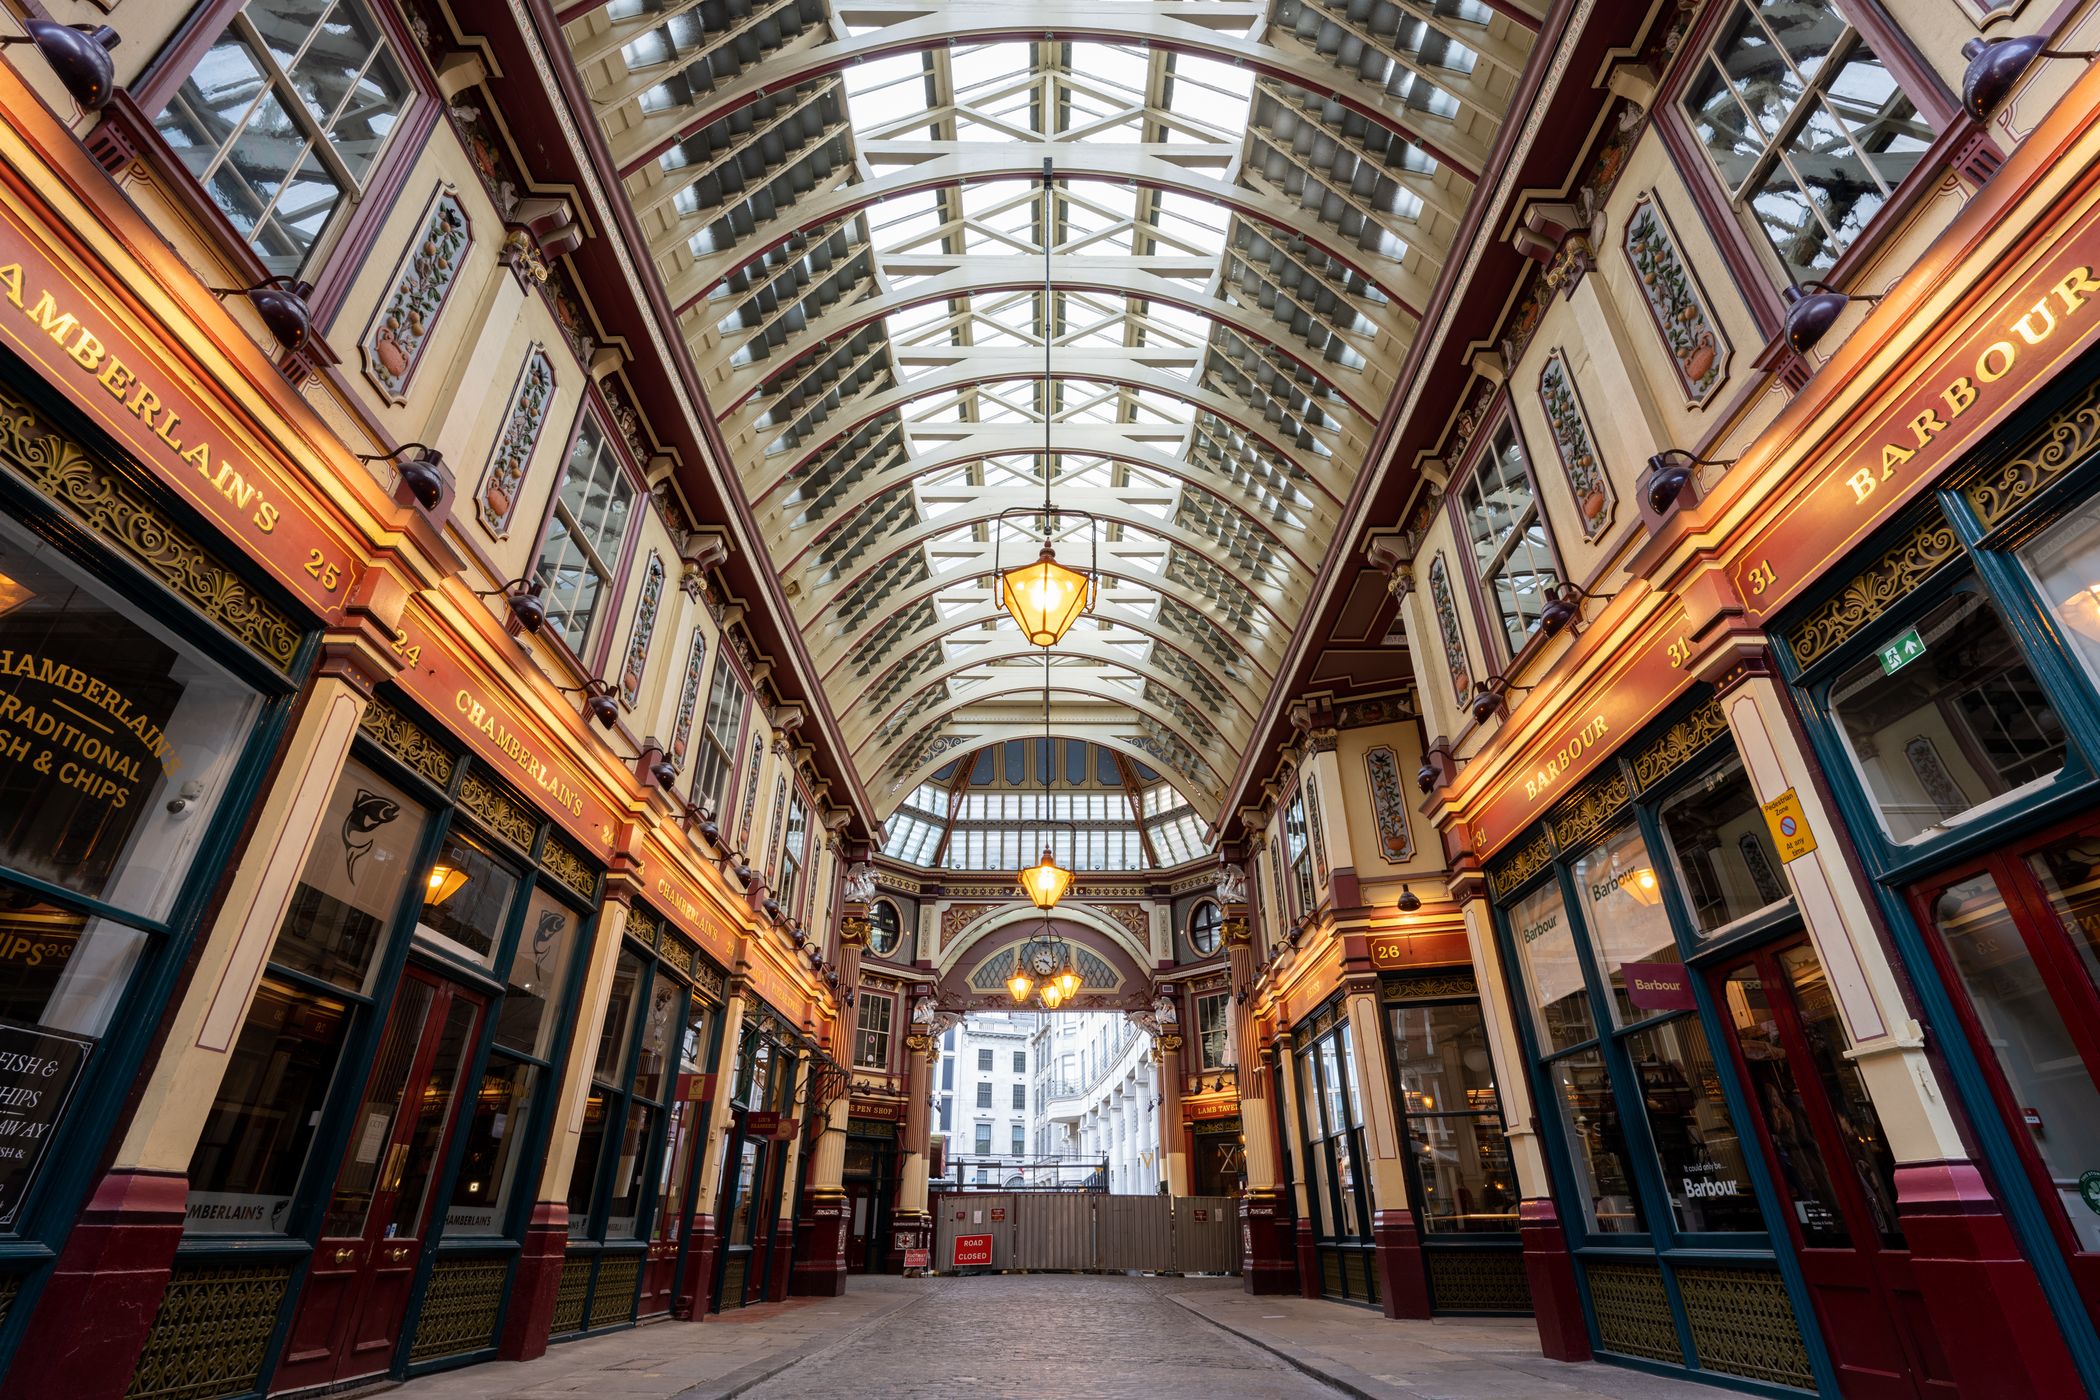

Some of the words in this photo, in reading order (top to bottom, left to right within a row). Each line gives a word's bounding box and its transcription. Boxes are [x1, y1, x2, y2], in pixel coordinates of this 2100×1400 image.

[1845, 264, 2100, 505] BARBOUR
[0, 262, 281, 536] AMBERLAIN'S
[304, 548, 340, 592] 25
[1747, 558, 1778, 597] 31
[1667, 635, 1691, 668] 31
[391, 628, 421, 668] 24
[455, 688, 584, 818] CHAMBERLAIN'S
[601, 824, 615, 848] 24
[1525, 714, 1609, 801] BARBOUR
[32, 749, 53, 775] &
[58, 762, 130, 808] CHIPS
[1764, 793, 1793, 811] Pedestrian
[1775, 805, 1789, 816] Zone
[1475, 826, 1487, 848] 31
[1786, 842, 1793, 850] At
[1794, 837, 1805, 847] any
[1792, 847, 1805, 857] time
[1591, 864, 1636, 902] Barbour
[657, 878, 718, 942] CHAMBERLAIN'S
[1523, 914, 1557, 944] Barbour
[1378, 945, 1400, 959] 26
[1634, 978, 1681, 991] Barbour
[41, 1060, 59, 1077] &
[856, 1105, 872, 1113] PEN
[873, 1107, 893, 1115] SHOP
[1197, 1105, 1217, 1115] LAMB
[15, 1149, 26, 1159] &
[1688, 1163, 1702, 1173] could
[1702, 1162, 1714, 1172] only
[185, 1204, 265, 1220] MBERLAIN'S
[963, 1239, 984, 1247] ROAD
